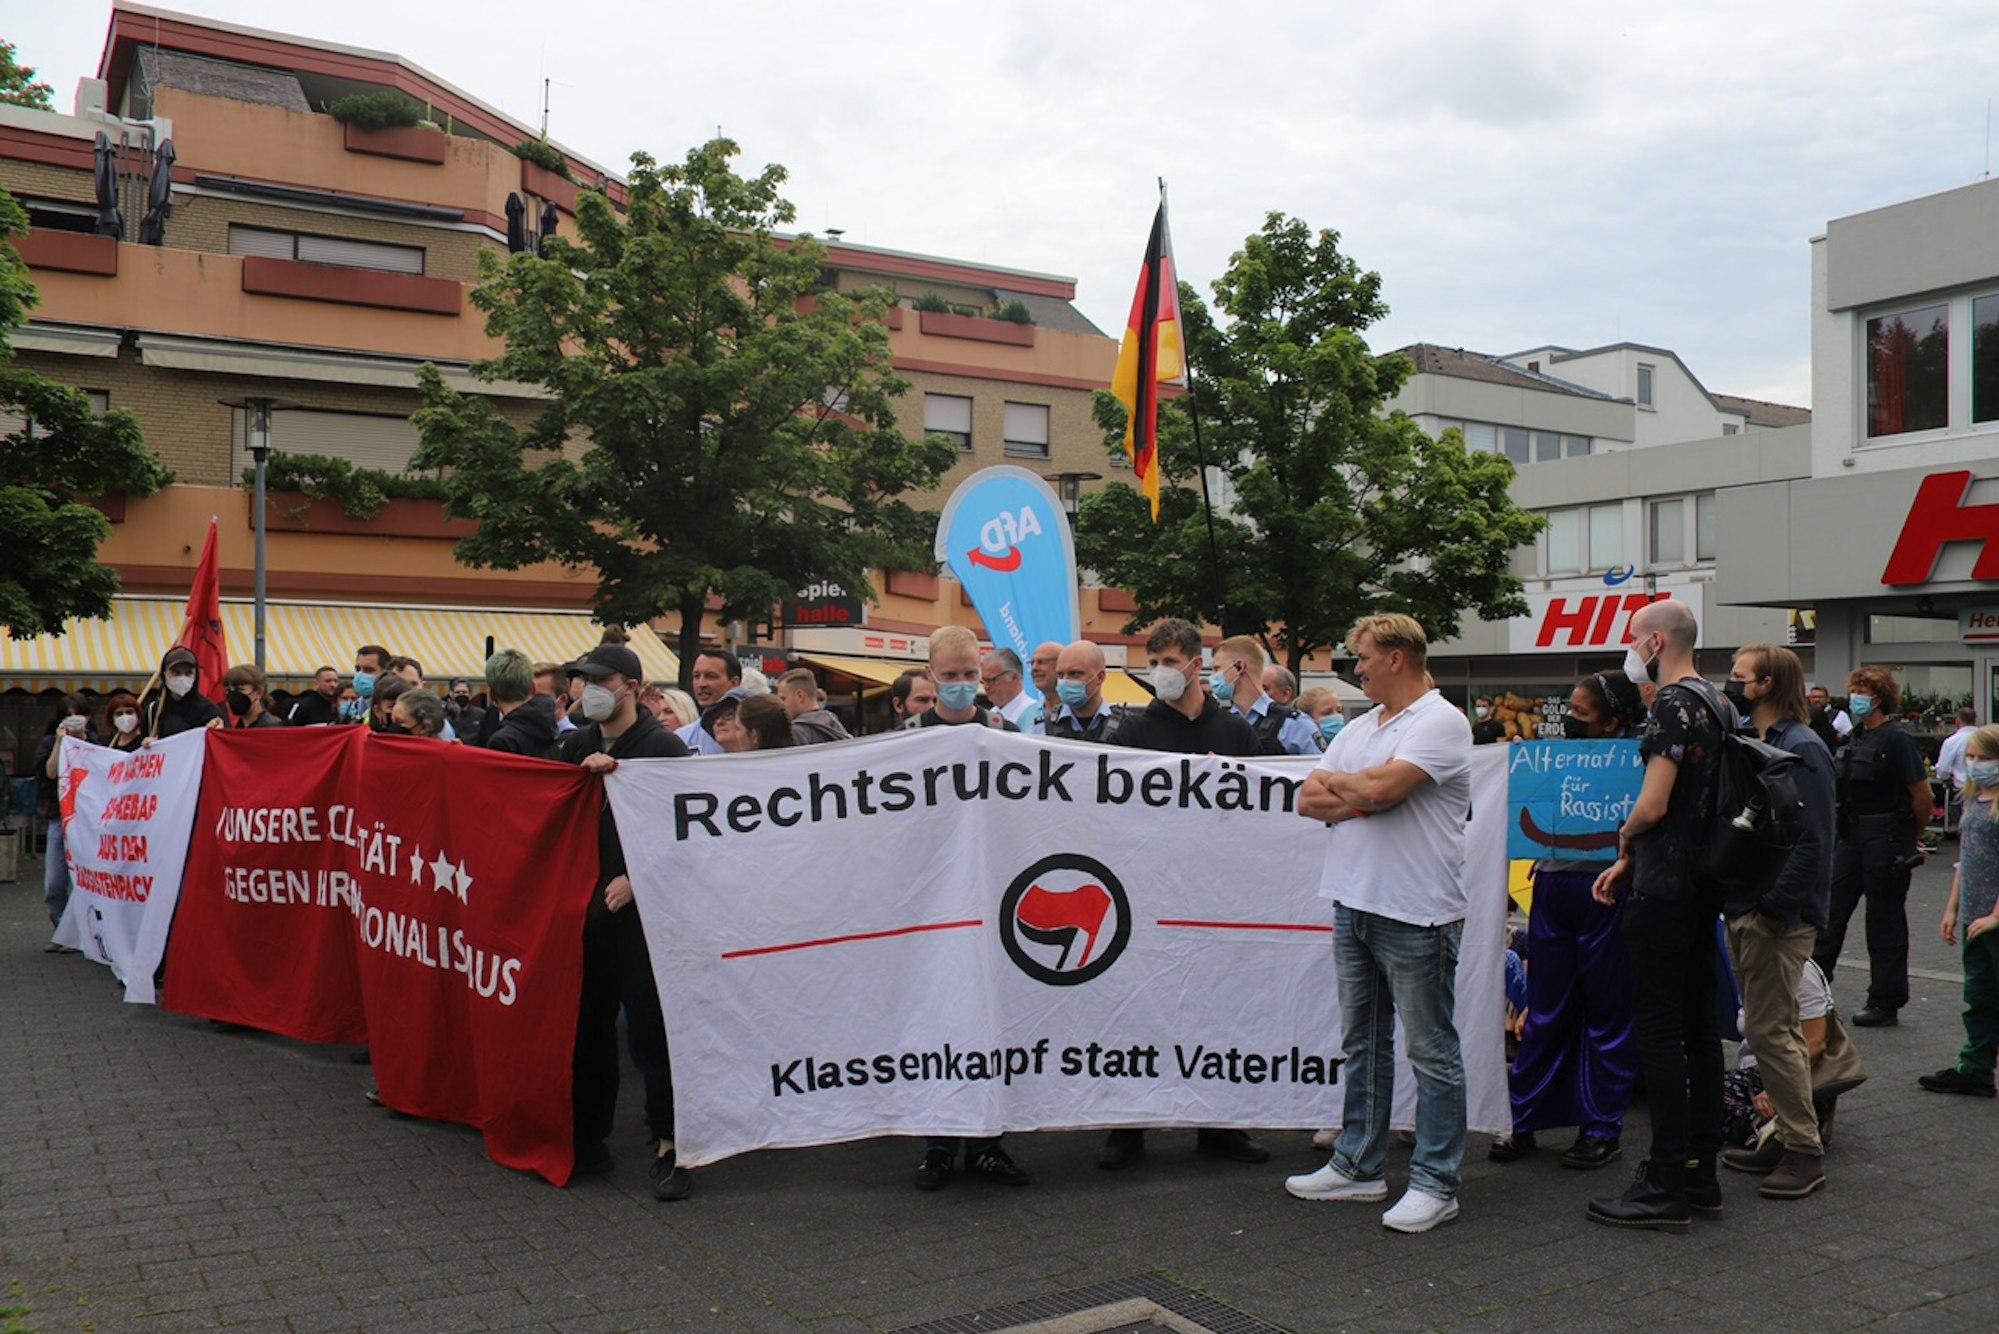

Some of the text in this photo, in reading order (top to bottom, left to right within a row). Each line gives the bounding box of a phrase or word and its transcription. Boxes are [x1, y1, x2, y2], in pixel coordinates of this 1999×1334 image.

[797, 580, 848, 602] spie
[796, 603, 849, 622] halle
[1969, 611, 1999, 628] He
[1542, 703, 1567, 715] GOLD
[1537, 722, 1566, 736] ERDE
[1510, 743, 1644, 775] Alternativ
[674, 749, 1305, 841] Rechtsruck bekäm
[1560, 775, 1591, 793] für
[1560, 791, 1638, 822] Rassist
[97, 834, 118, 861] AUS
[224, 866, 310, 904] GEGEN
[1060, 1041, 1160, 1078] statt
[1174, 1044, 1347, 1086] Vaterlan
